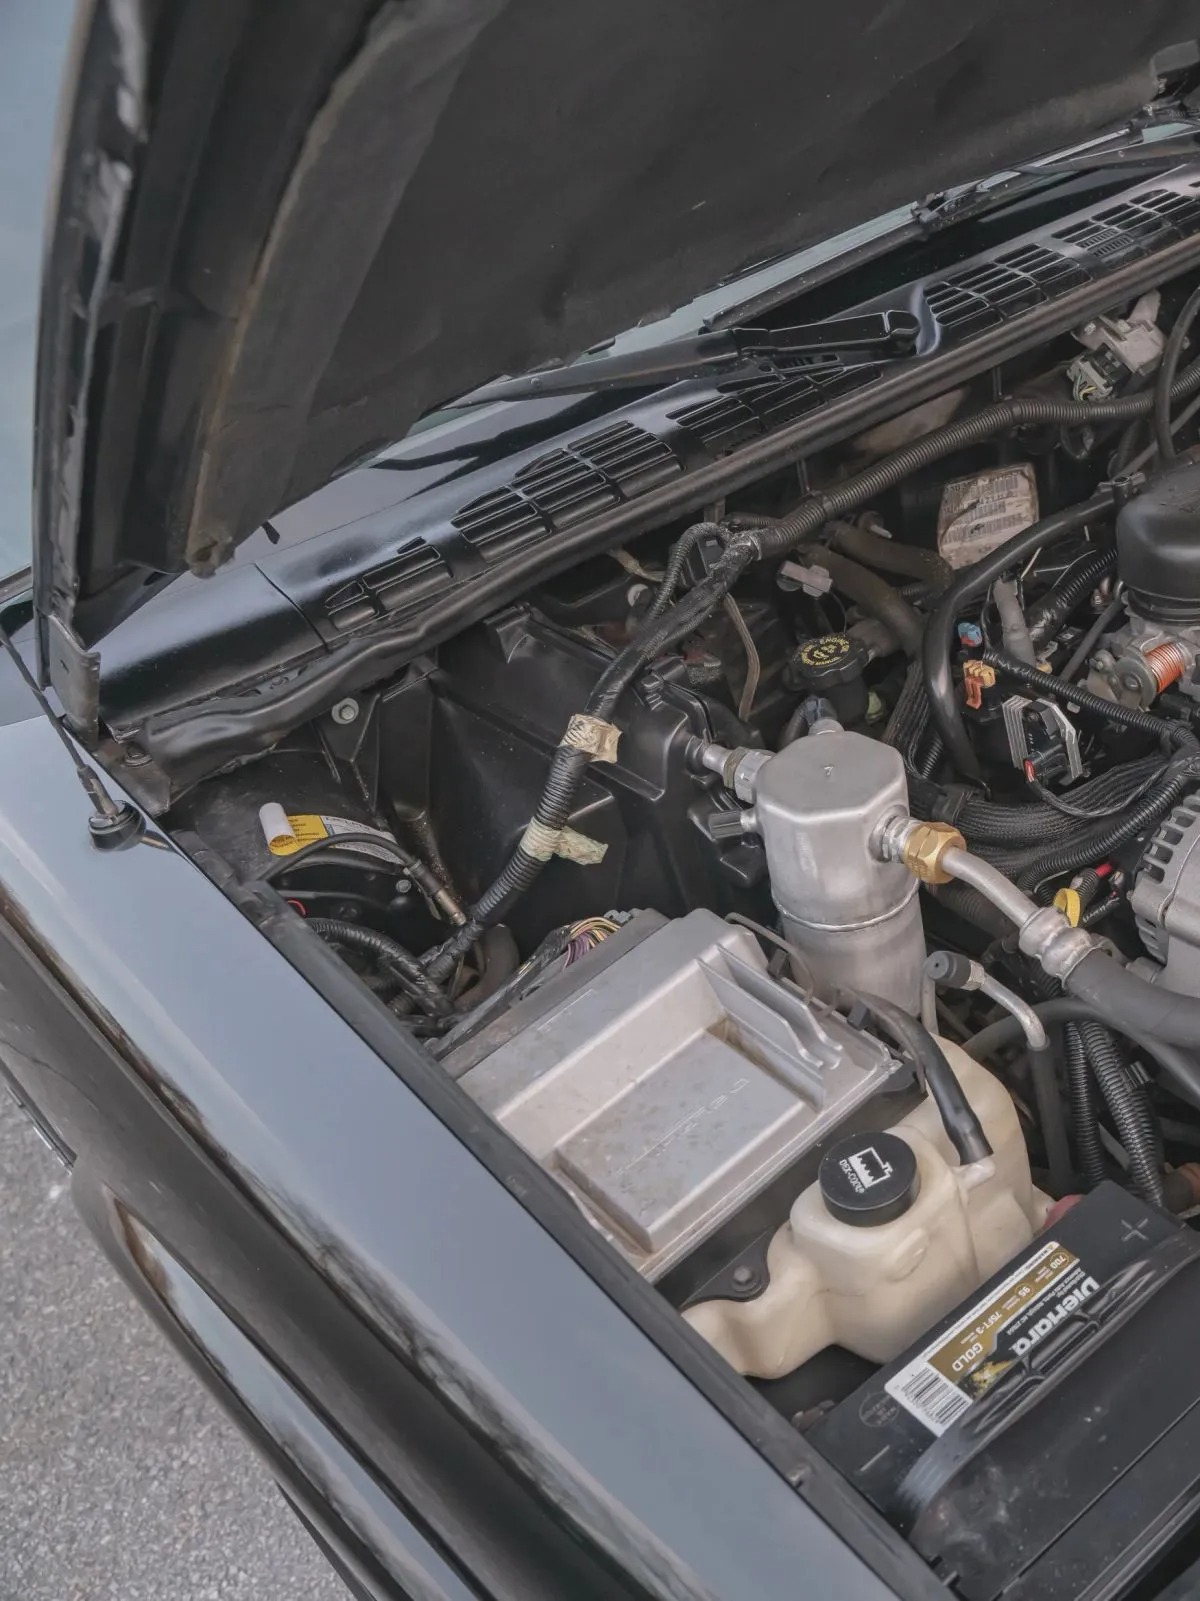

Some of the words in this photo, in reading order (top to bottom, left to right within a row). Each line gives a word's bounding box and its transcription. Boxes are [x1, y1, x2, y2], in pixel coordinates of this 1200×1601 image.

[1050, 1255, 1066, 1269] 700
[1018, 1286, 1031, 1297] 95
[952, 1342, 983, 1372] GOLD
